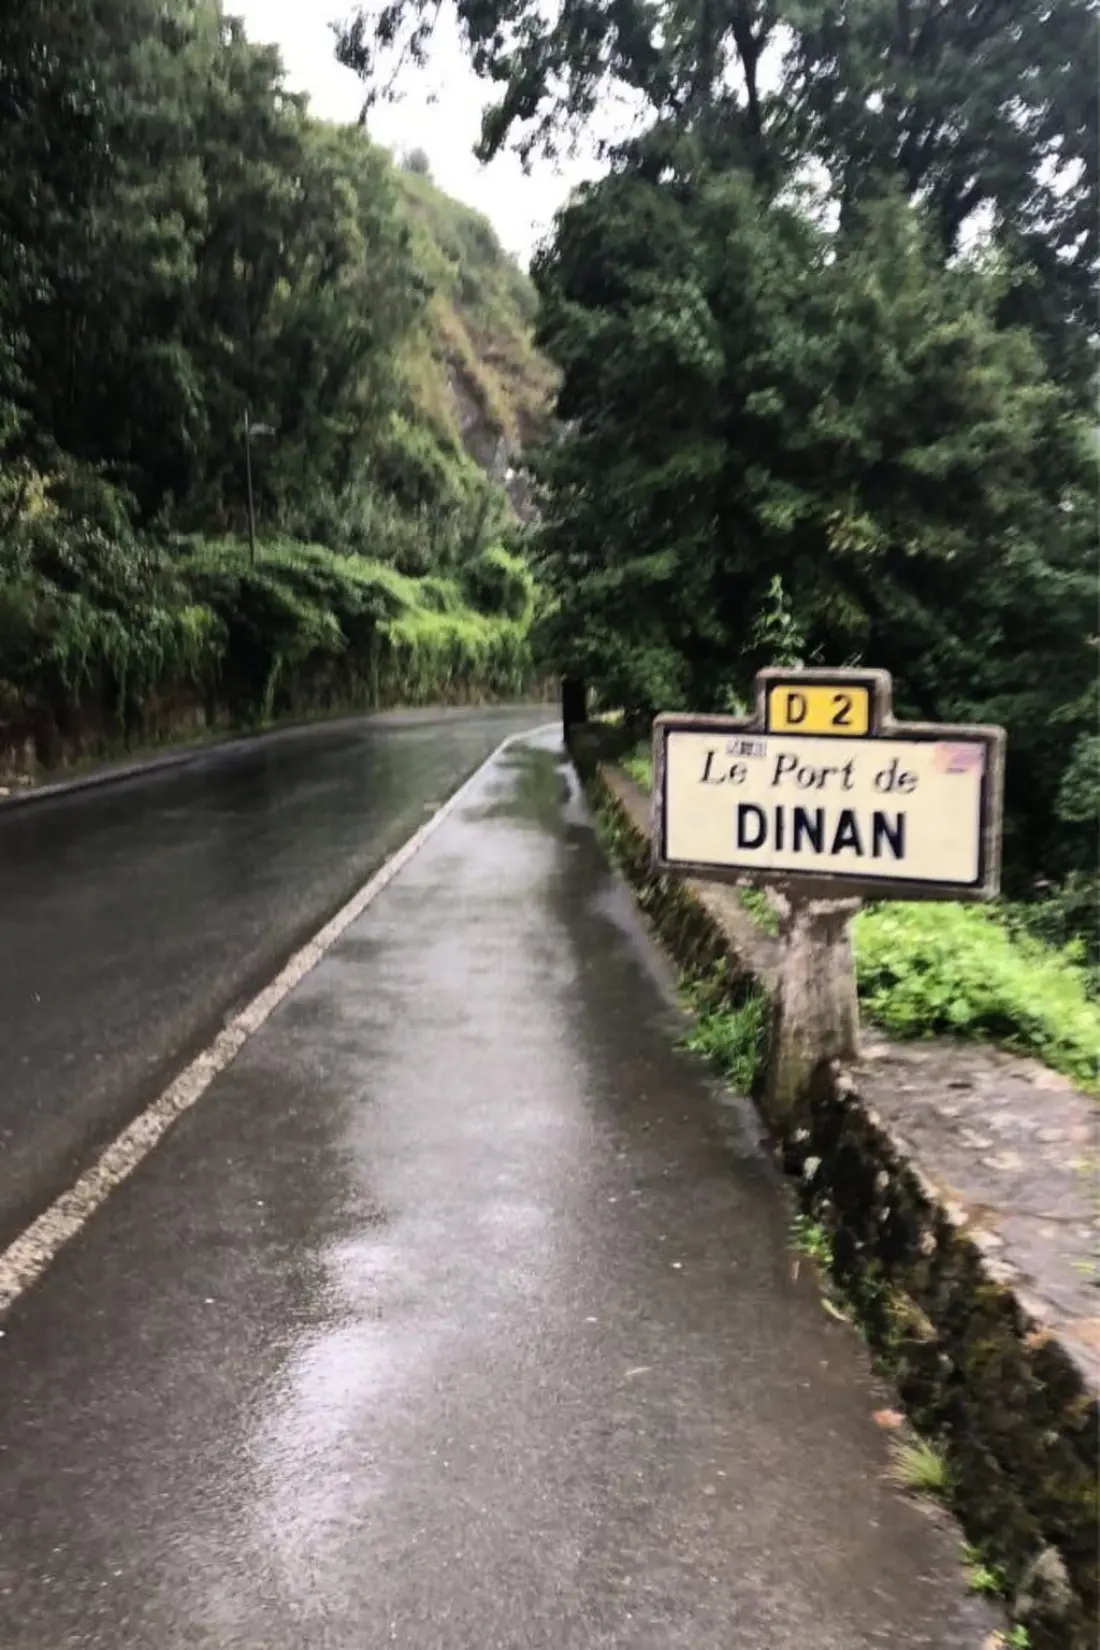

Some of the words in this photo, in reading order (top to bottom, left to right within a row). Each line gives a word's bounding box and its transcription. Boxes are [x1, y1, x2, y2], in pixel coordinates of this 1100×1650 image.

[786, 693, 808, 724] D
[831, 693, 853, 725] 2
[700, 750, 748, 785] Le
[771, 752, 855, 790] Port
[874, 757, 920, 794] de
[737, 803, 905, 860] DINAN
